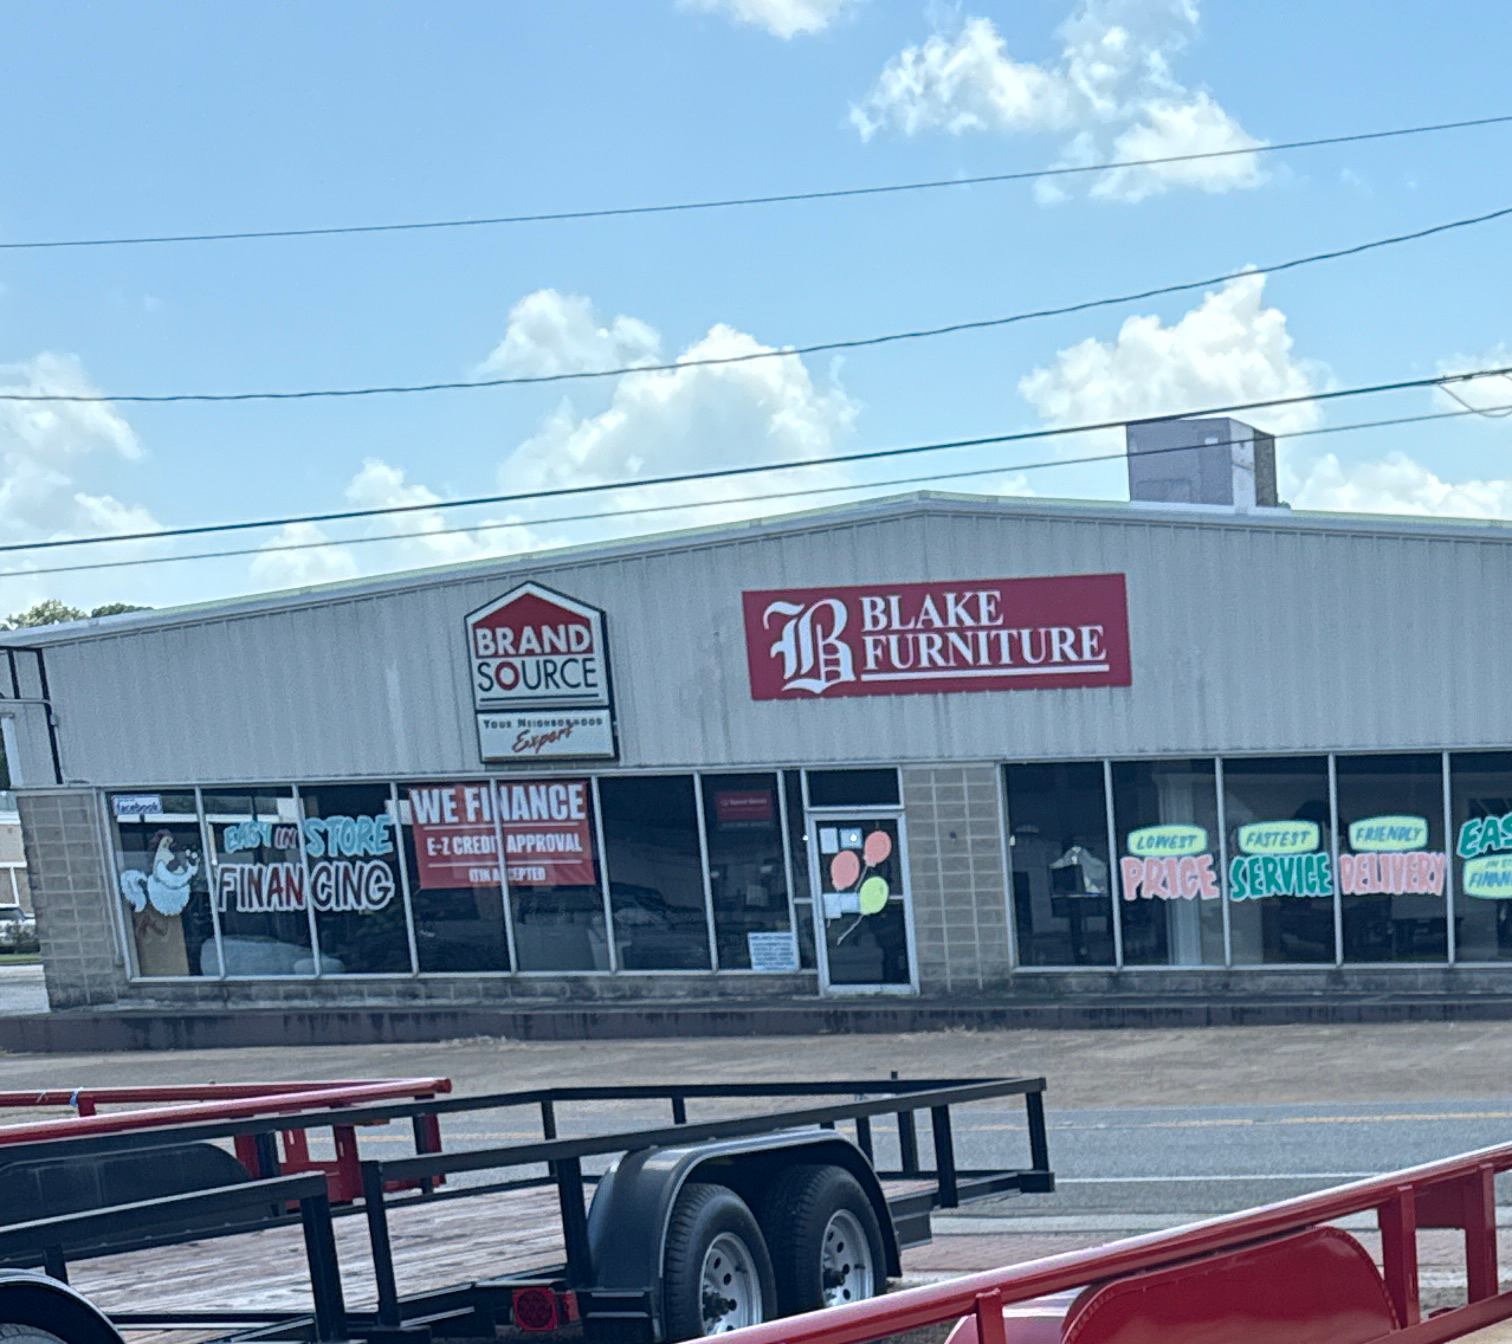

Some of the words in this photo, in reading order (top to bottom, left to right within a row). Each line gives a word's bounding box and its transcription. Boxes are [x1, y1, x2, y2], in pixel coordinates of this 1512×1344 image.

[859, 589, 1004, 634] BLAKE
[475, 623, 593, 656] BRAND
[861, 625, 1107, 671] FURNITURE
[477, 657, 598, 692] SOURCE
[512, 723, 574, 754] Expert
[410, 788, 459, 825] WE
[464, 784, 586, 823] FINANCE
[224, 821, 272, 854] EASY
[274, 825, 297, 849] IN
[305, 814, 394, 857] STORE
[427, 837, 450, 856] E-Z
[507, 833, 583, 853] APPROVAL
[1135, 833, 1198, 850] LOWEST
[1245, 829, 1310, 848] FASTEST
[1355, 825, 1424, 844] FRIENDLY
[216, 859, 395, 912] FINANCING
[1120, 854, 1220, 901] PRICE
[1229, 852, 1333, 902] SERVICE
[1339, 851, 1445, 896] DELIVERY
